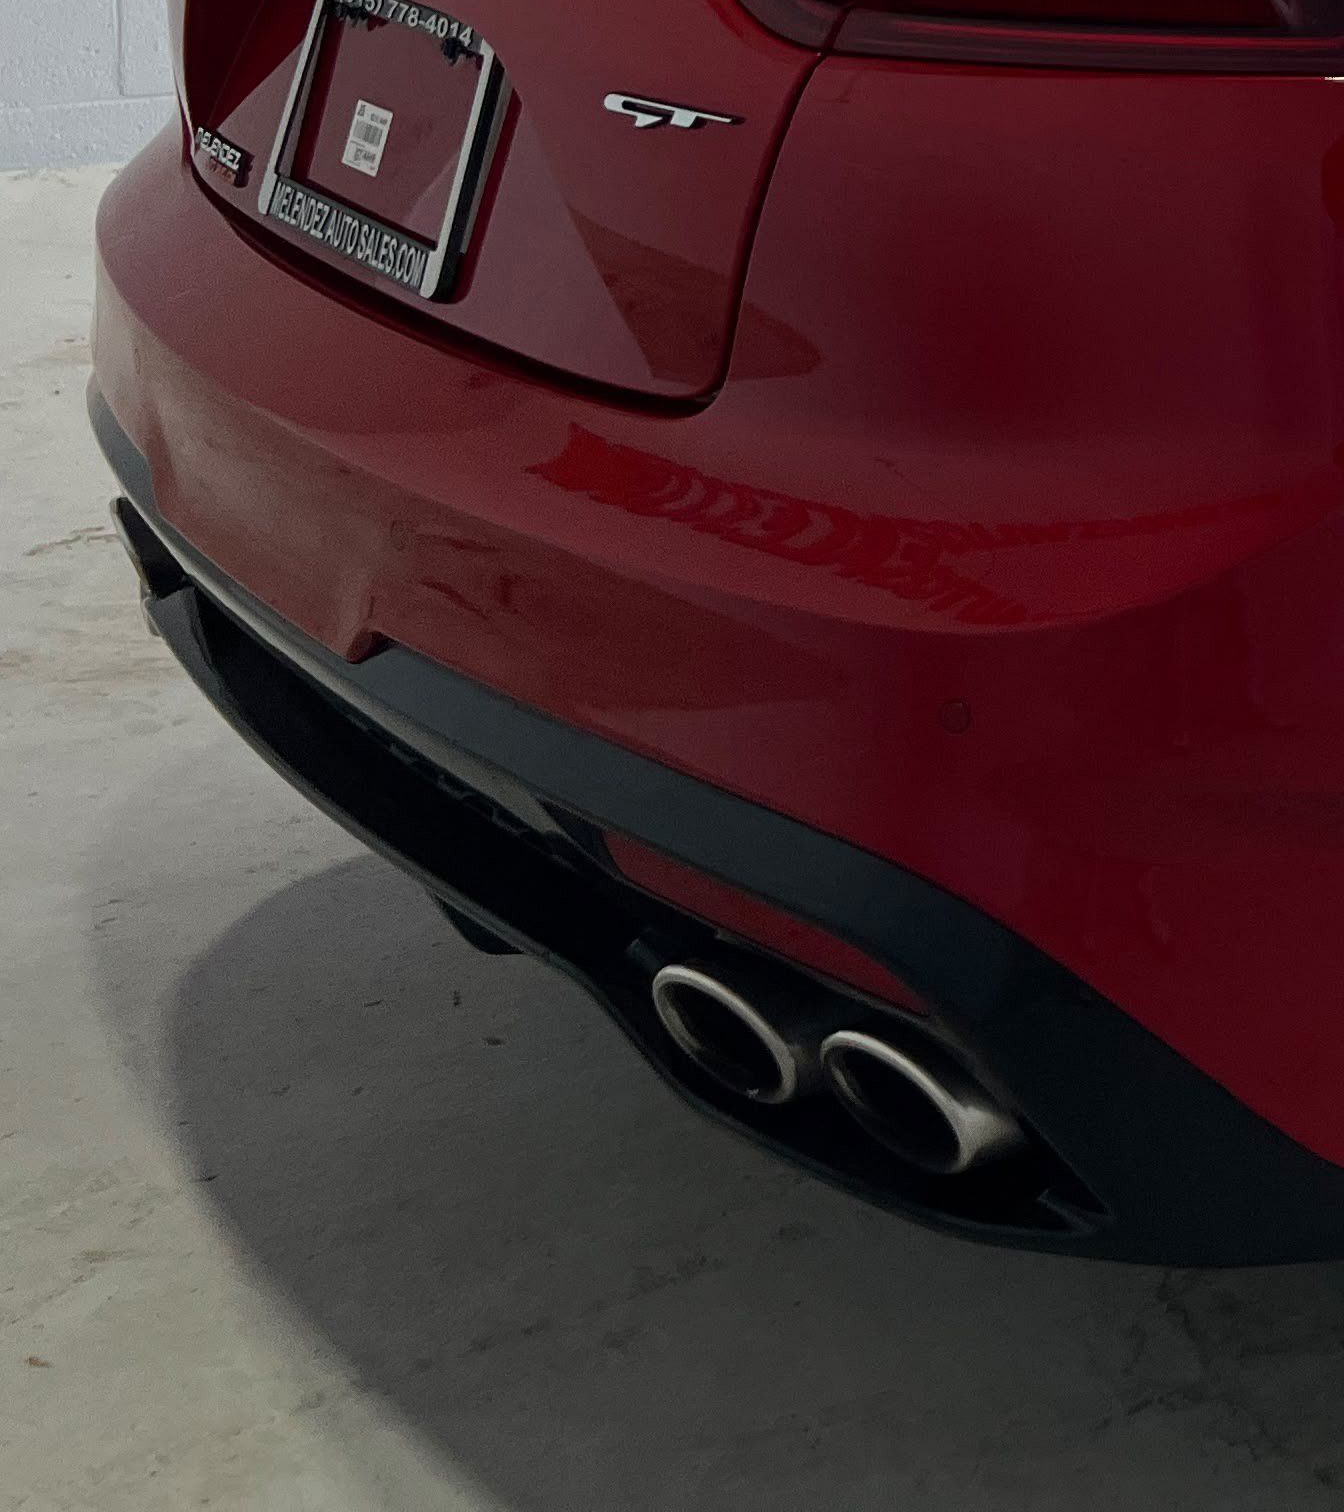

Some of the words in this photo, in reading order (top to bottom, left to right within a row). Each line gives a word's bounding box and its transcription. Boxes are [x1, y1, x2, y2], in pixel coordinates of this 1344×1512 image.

[387, 0, 472, 47] 778-4014
[604, 93, 732, 127] GT
[269, 180, 330, 239] MELENDEZ
